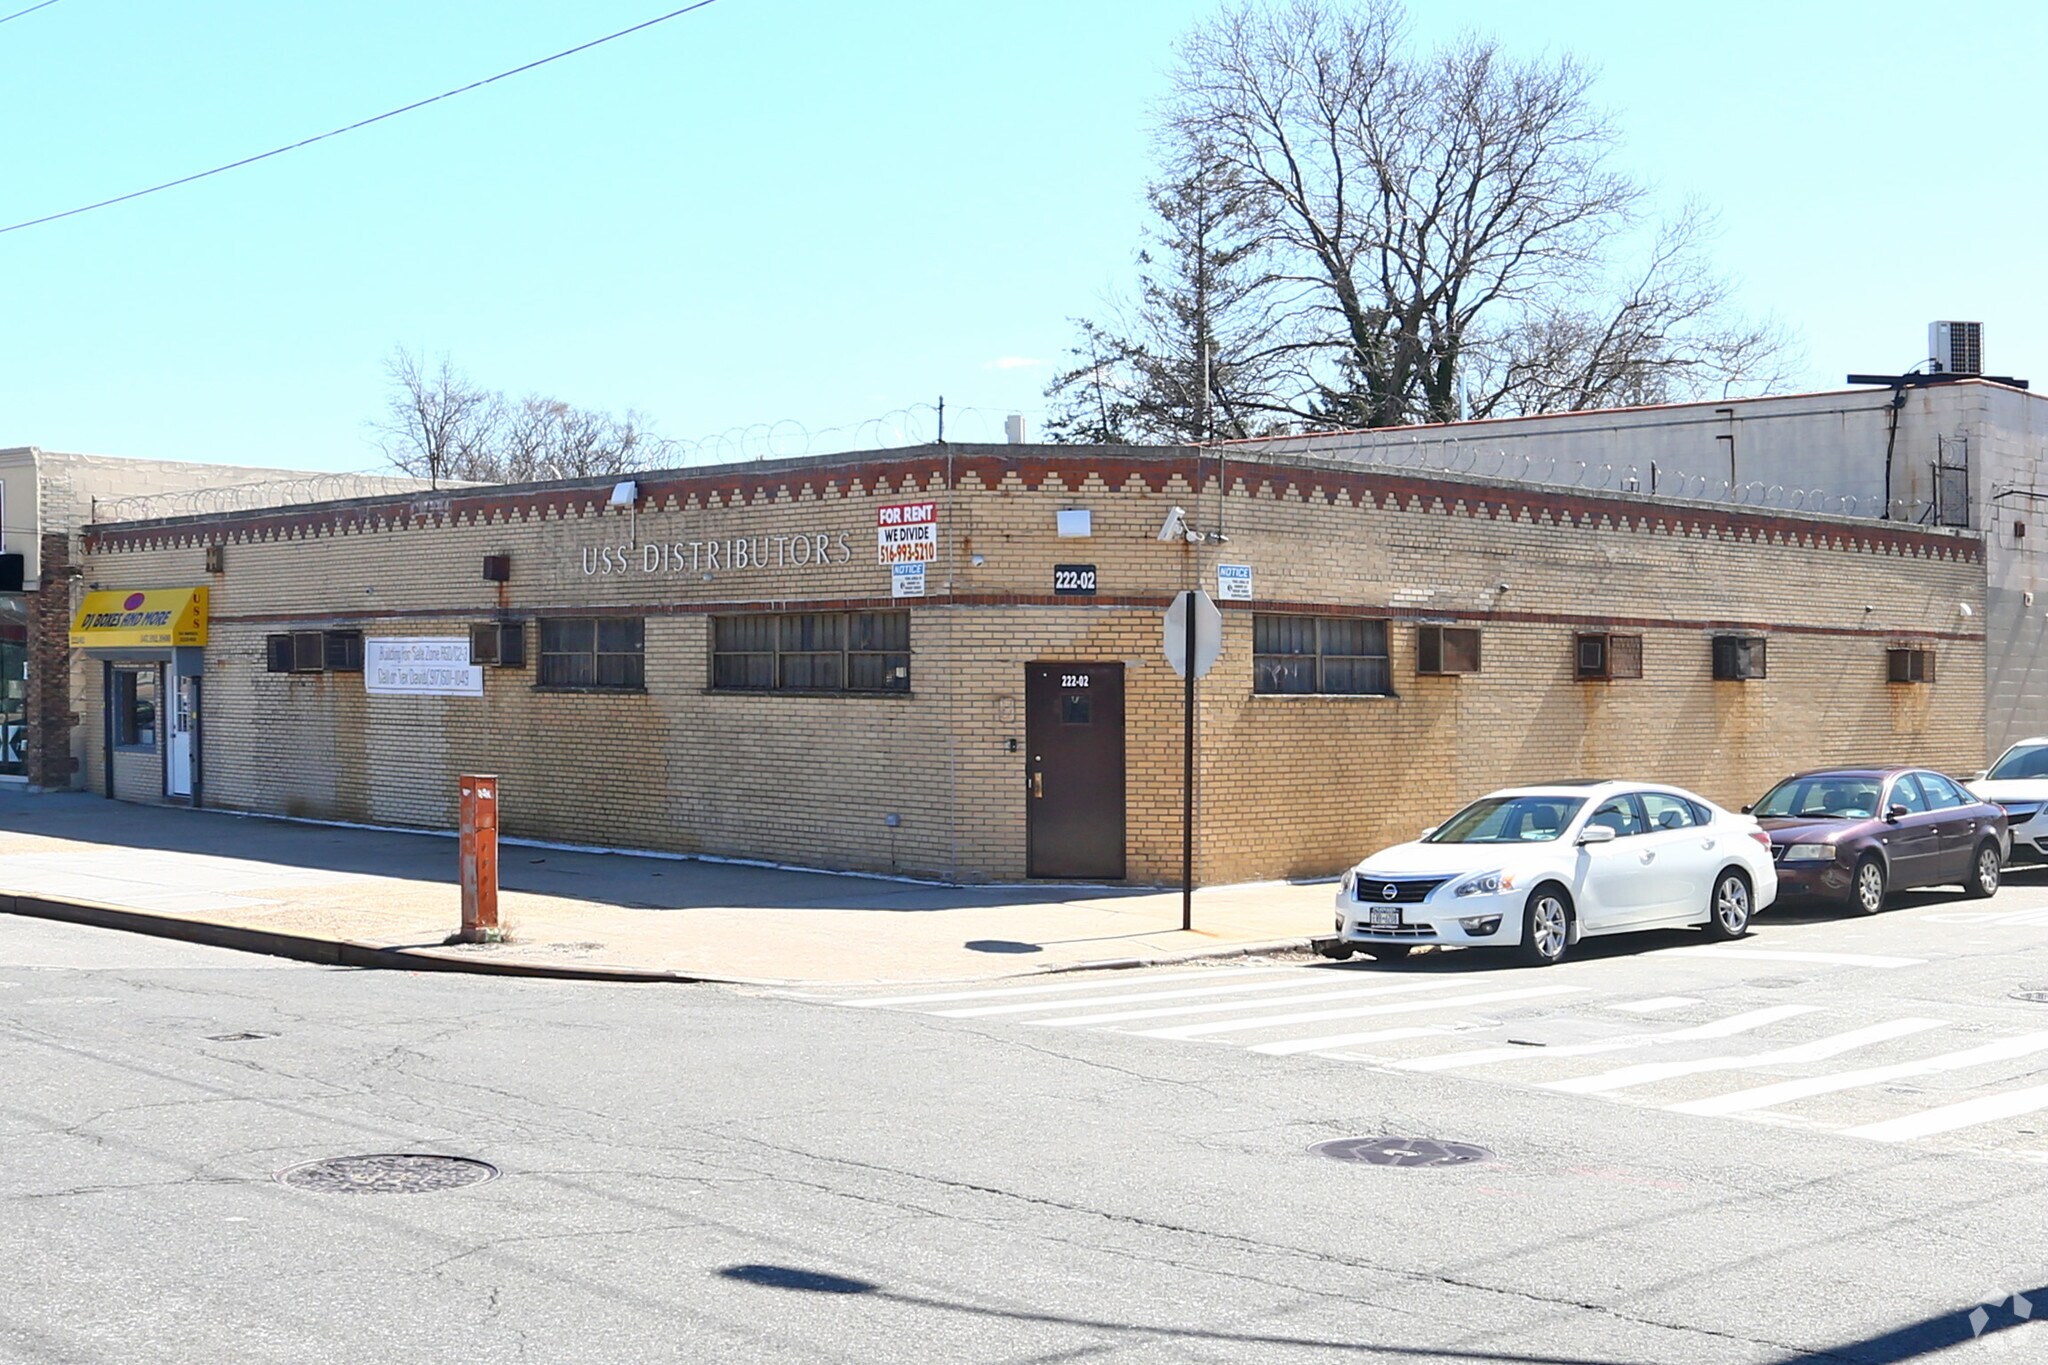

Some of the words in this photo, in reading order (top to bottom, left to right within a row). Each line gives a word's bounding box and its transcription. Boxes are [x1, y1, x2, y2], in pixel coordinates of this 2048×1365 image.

[880, 508, 901, 525] FOR
[903, 505, 933, 523] RENT
[884, 528, 898, 542] WE
[900, 526, 929, 541] DIVIDE
[583, 545, 629, 576] USS
[643, 532, 852, 573] DISTRIBUTORS
[880, 542, 934, 563] 516-993-5210
[894, 564, 922, 574] NOTICE
[1220, 567, 1249, 577] NOTICE
[1055, 571, 1095, 589] 222-02
[93, 612, 122, 628] BOXES
[120, 611, 144, 627] AND
[141, 610, 172, 626] MORE
[1061, 675, 1089, 687] 222-02
